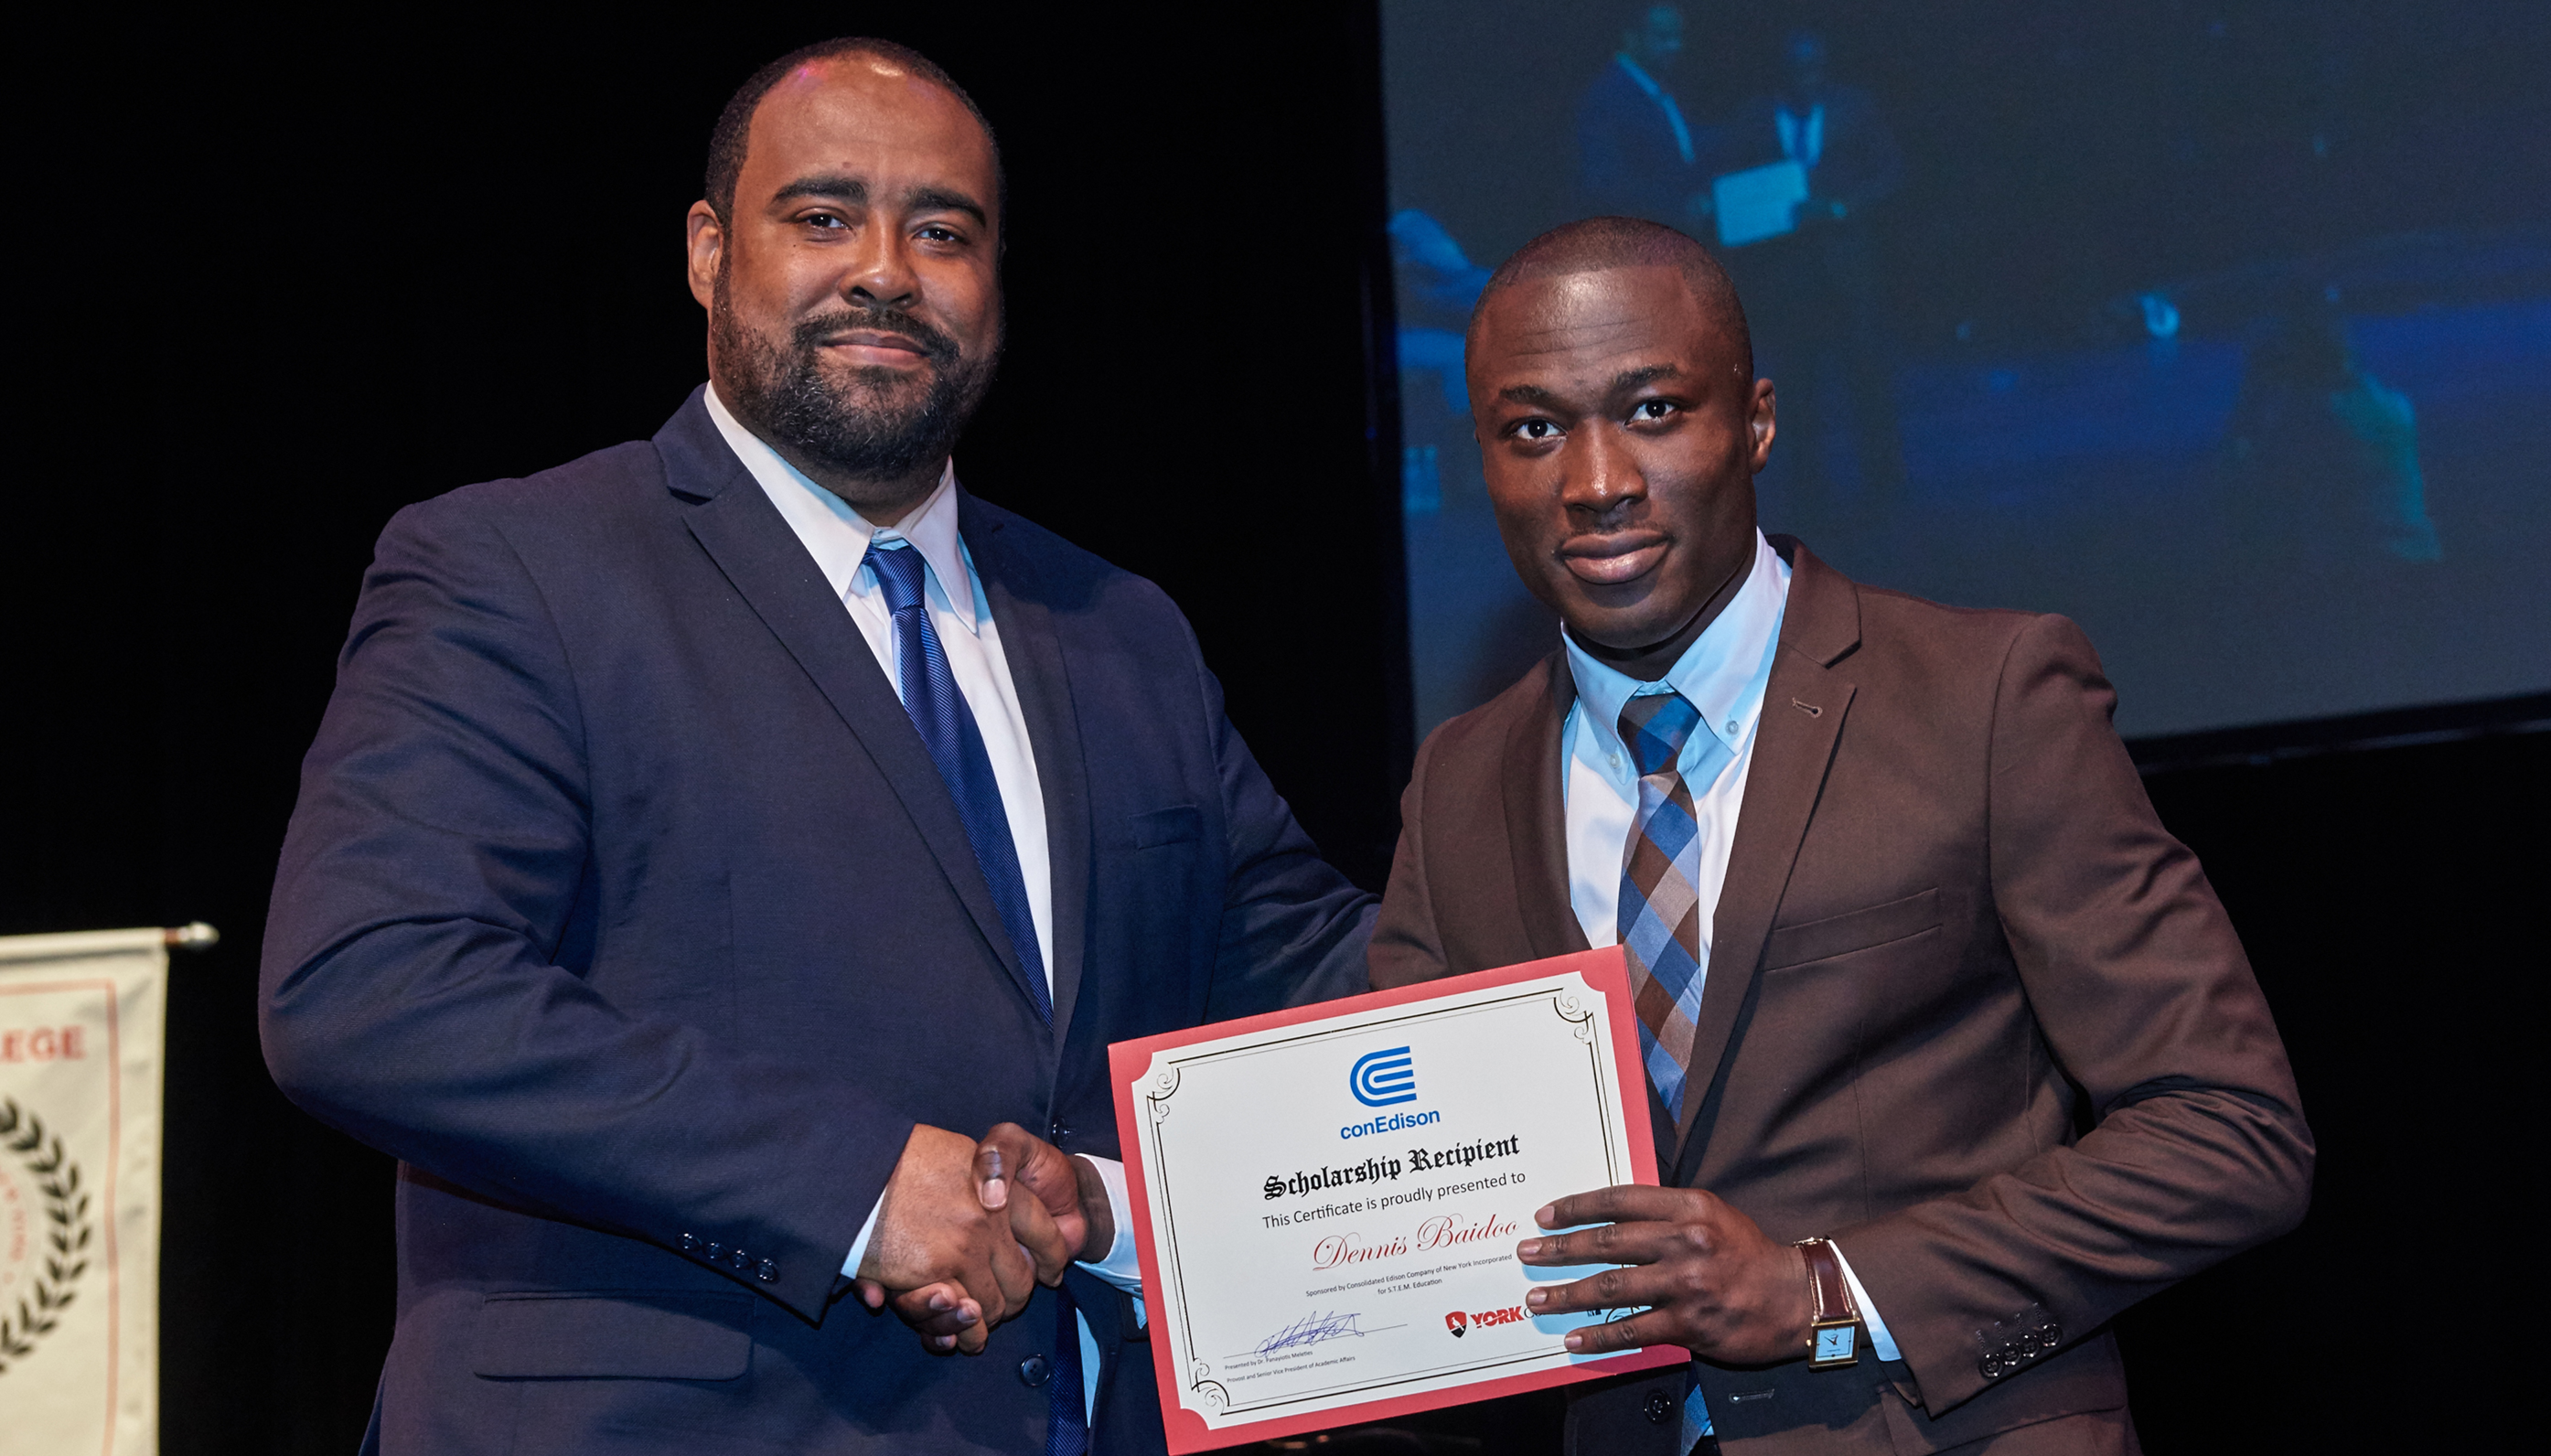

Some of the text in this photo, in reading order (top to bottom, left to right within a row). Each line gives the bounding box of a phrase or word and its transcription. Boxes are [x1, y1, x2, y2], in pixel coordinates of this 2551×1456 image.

[1340, 1110, 1441, 1140] conEdison
[1263, 1134, 1520, 1200] Scholarship Recipient
[1262, 1172, 1527, 1228] This Certificate is proudly presented to
[1313, 1213, 1520, 1271] Dennis Baidoo
[1306, 1285, 1337, 1297] Sponsored
[1346, 1277, 1385, 1289] Consolidated
[1386, 1274, 1406, 1282] Edison
[1407, 1269, 1435, 1279] Company
[1458, 1261, 1473, 1269] York
[1473, 1254, 1513, 1266] Incorporated
[1388, 1283, 1411, 1293] S.T.E.M.
[1413, 1278, 1442, 1288] Education
[1470, 1306, 1525, 1329] YORK
[1225, 1361, 1250, 1371] Presented
[1285, 1363, 1309, 1373] President
[1315, 1358, 1339, 1368] Academic
